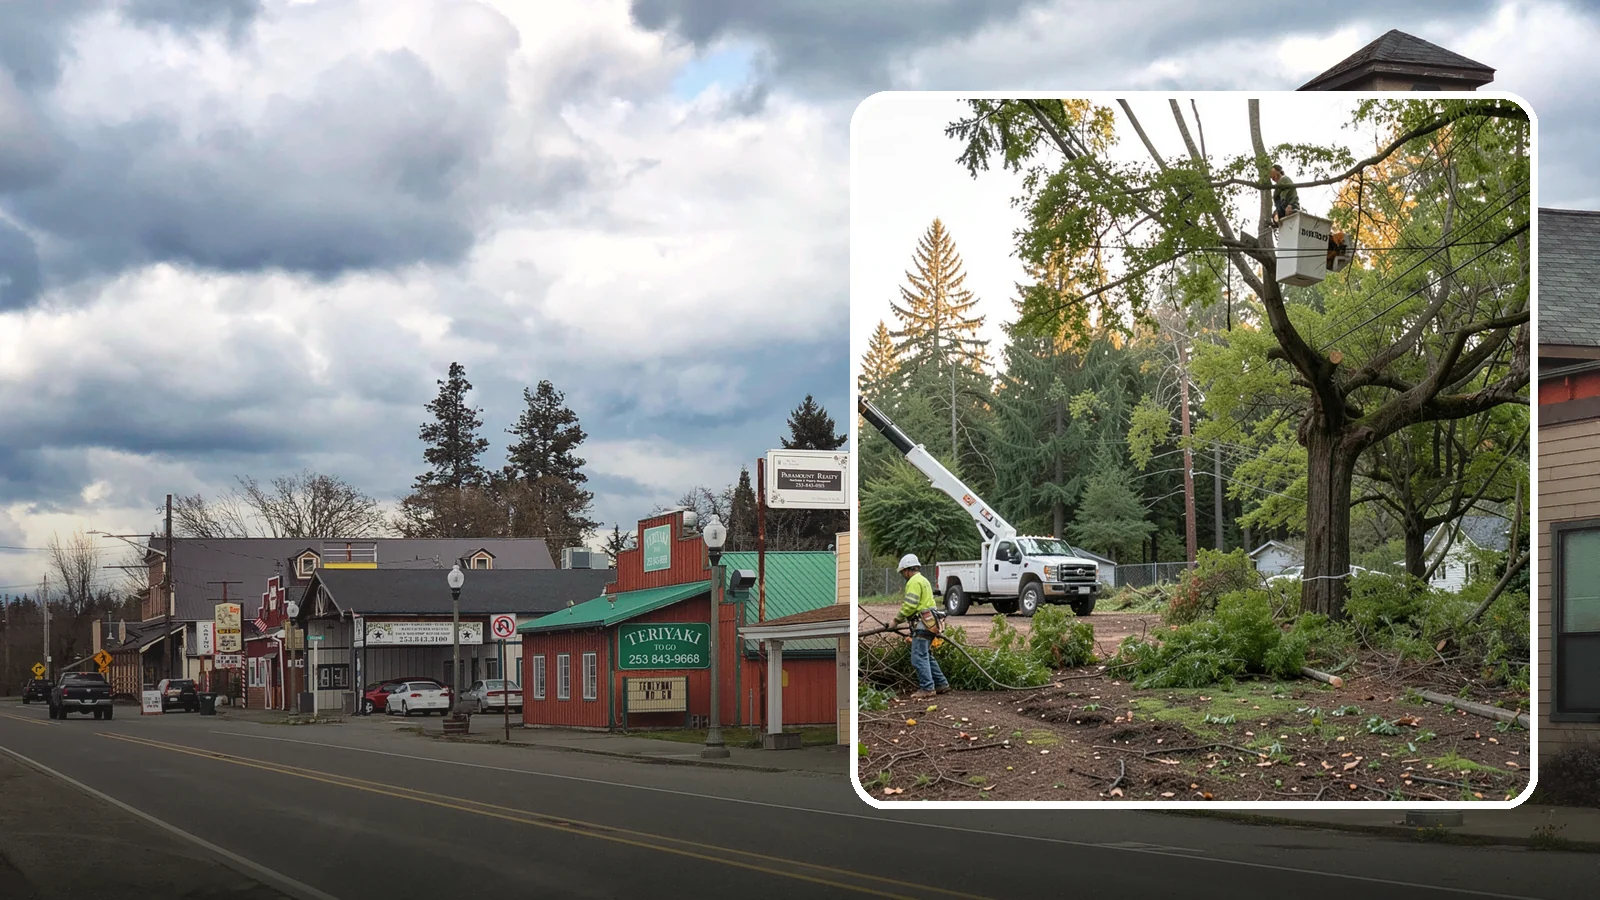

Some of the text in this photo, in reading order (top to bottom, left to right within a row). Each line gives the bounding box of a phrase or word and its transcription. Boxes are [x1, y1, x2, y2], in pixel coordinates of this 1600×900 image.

[781, 471, 838, 480] PARAMOUNT REALTY
[624, 627, 702, 646] TERIYAKI
[628, 653, 700, 665] 253 843-9668
